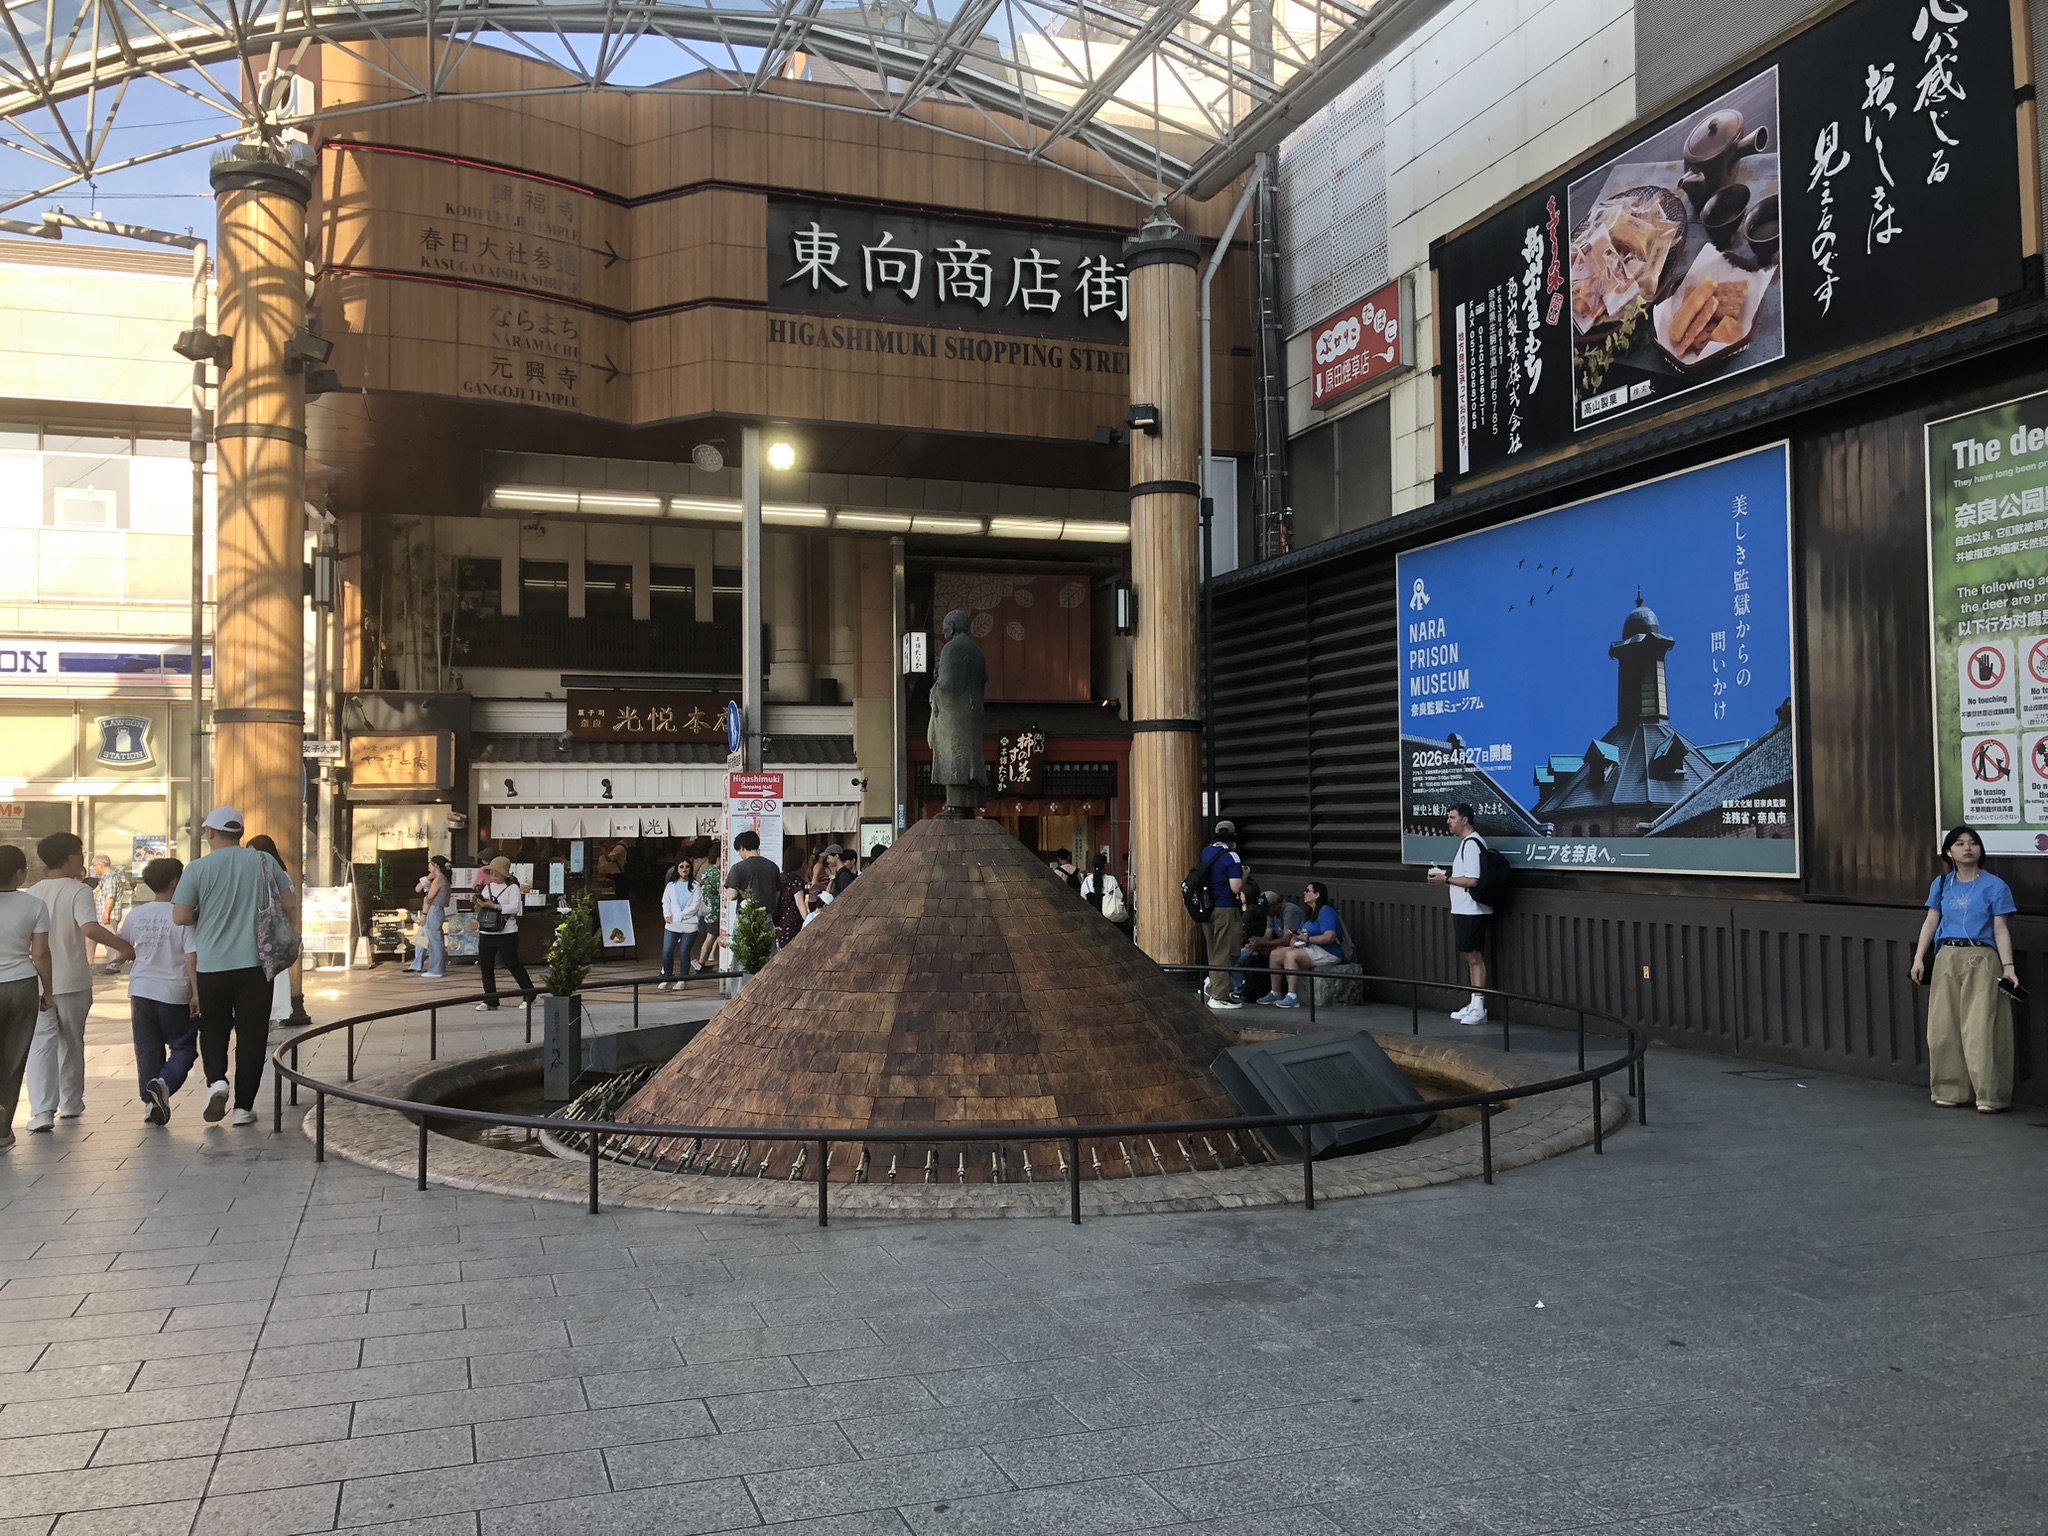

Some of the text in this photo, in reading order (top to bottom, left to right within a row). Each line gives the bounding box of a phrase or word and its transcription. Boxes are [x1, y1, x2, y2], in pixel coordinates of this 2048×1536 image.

[491, 182, 576, 223] 興福寺
[532, 221, 580, 242] TEMPLE
[419, 226, 578, 278] 春日大社参道
[420, 255, 580, 294] KASUGATAISHA SHRINE
[785, 221, 1129, 322] 東向商店街
[489, 304, 579, 340] ならまち
[1363, 305, 1396, 340] たばこ
[492, 332, 580, 358] NARAMACHI
[768, 318, 938, 358] HIGASHIMUKI
[944, 336, 1063, 369] SHOPPING
[490, 356, 578, 390] 元興寺
[463, 381, 580, 408] GANGOJI TEMPLE
[1583, 392, 1618, 416] 高山製菓
[1952, 424, 2048, 470] The de
[1953, 479, 1973, 488] They
[1974, 472, 1994, 484] have
[1995, 468, 2014, 479] long
[2015, 462, 2037, 474] been
[1954, 485, 2048, 528] 奈良公园
[1731, 493, 1752, 688] 美しき監獄からの
[1957, 586, 1978, 598] The
[1981, 578, 2035, 595] following
[1961, 602, 1979, 613] the
[1982, 599, 2008, 611] deer
[2011, 595, 2031, 606] are
[1409, 617, 1446, 643] NARA
[1409, 642, 1459, 670] PRISON
[1410, 668, 1470, 697] MUSEUM
[1710, 630, 1727, 720] 問いかけ
[1967, 695, 2008, 705] No touching
[2030, 687, 2041, 695] No
[1410, 696, 1484, 718] 奈良監獄ミュージアム
[102, 719, 144, 728] LAWSON
[580, 719, 602, 728] 奈良
[102, 751, 144, 760] STATION
[303, 744, 339, 754] 女子大学
[1412, 743, 1512, 768] 2026年4月27日開館
[733, 774, 781, 785] Higashimuki
[1974, 787, 2006, 797] No teasing
[2031, 782, 2041, 790] Do
[1985, 796, 2012, 804] crackers
[645, 817, 720, 836] 光 悦
[1721, 811, 1787, 825] 法務省・奈良市
[1525, 842, 1616, 864] リニアを奈良へ。
